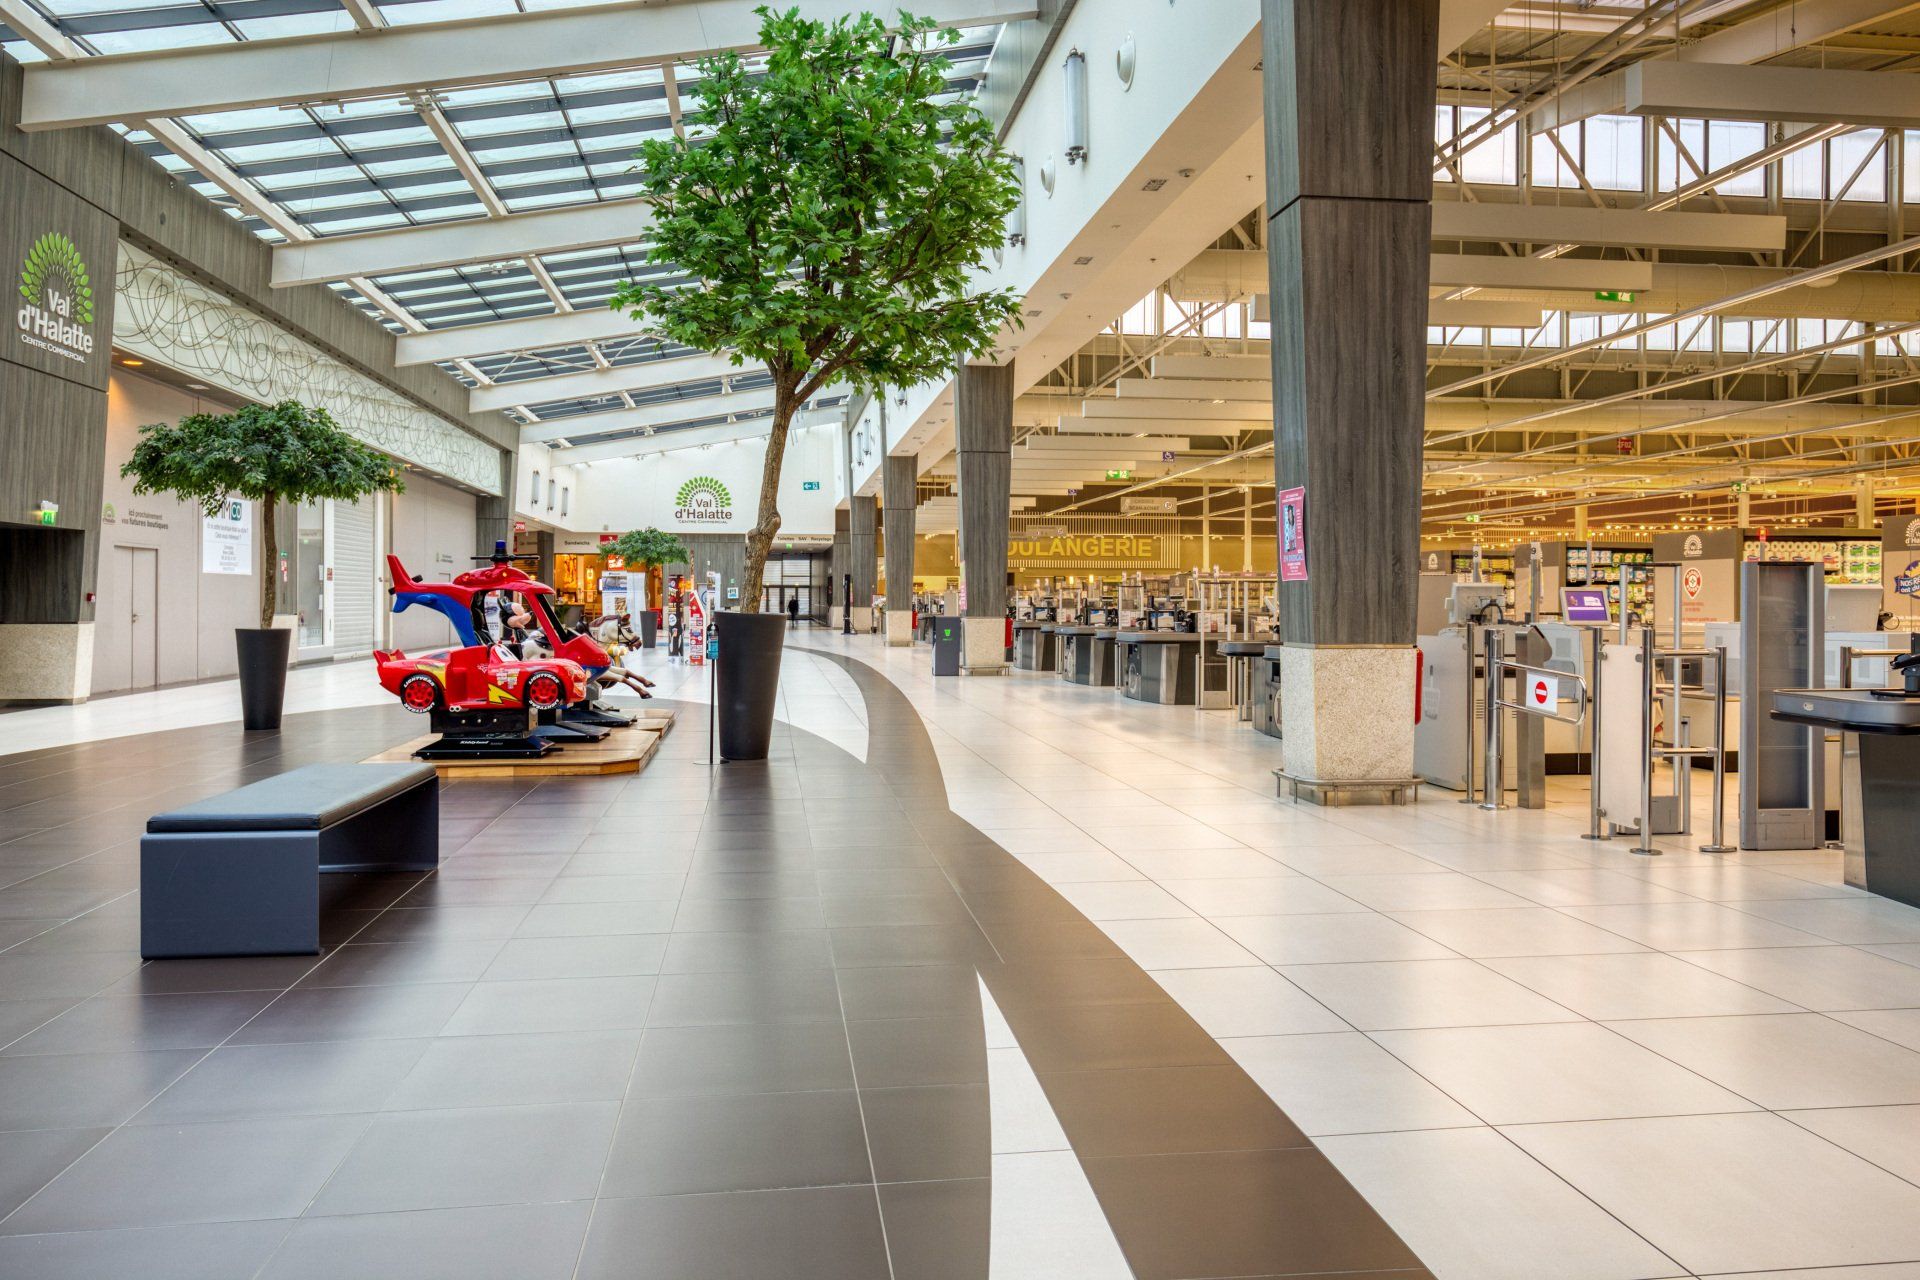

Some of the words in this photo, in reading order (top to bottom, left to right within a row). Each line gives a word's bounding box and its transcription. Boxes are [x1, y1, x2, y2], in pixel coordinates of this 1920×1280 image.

[47, 288, 70, 318] Val
[17, 304, 93, 354] d'Halatte
[21, 334, 48, 350] CENTRE
[47, 343, 86, 364] COMMERCIAL
[674, 508, 733, 520] d'Halatte
[695, 499, 712, 508] Val
